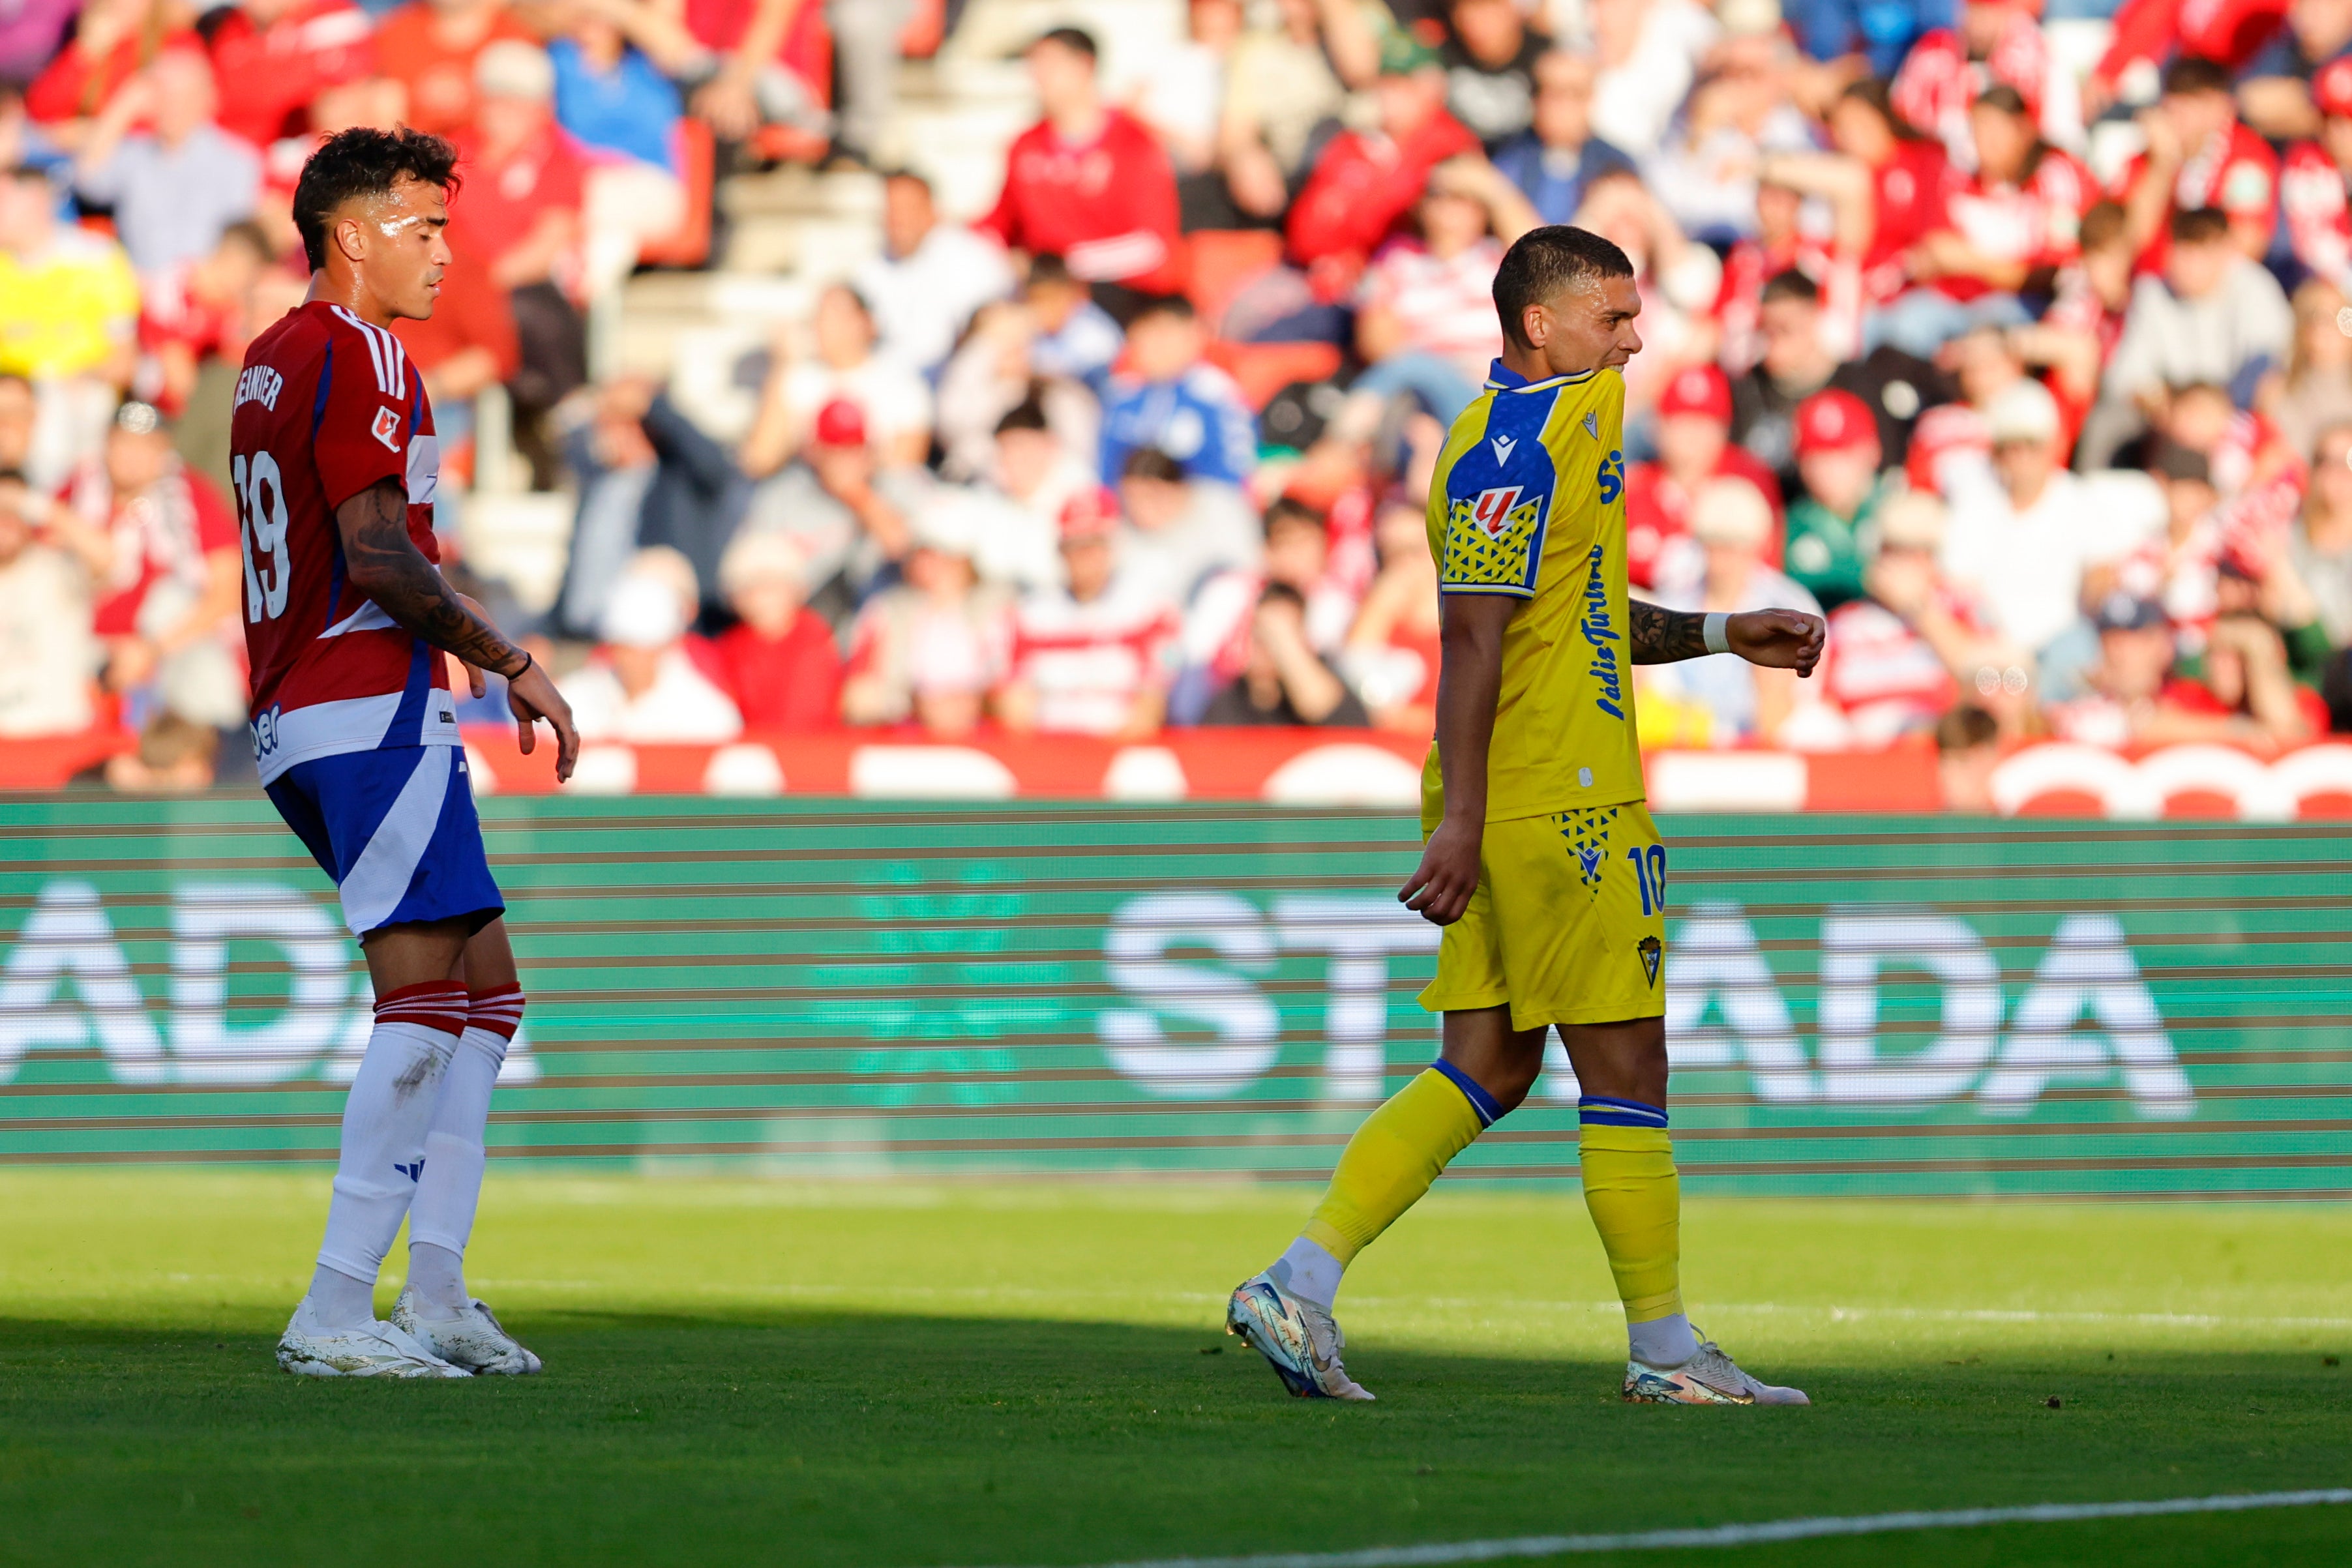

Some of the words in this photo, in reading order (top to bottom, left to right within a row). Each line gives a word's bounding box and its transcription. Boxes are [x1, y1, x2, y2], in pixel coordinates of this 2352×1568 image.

[234, 451, 291, 623] 19
[1626, 843, 1667, 917] 10
[0, 878, 545, 1087] AD
